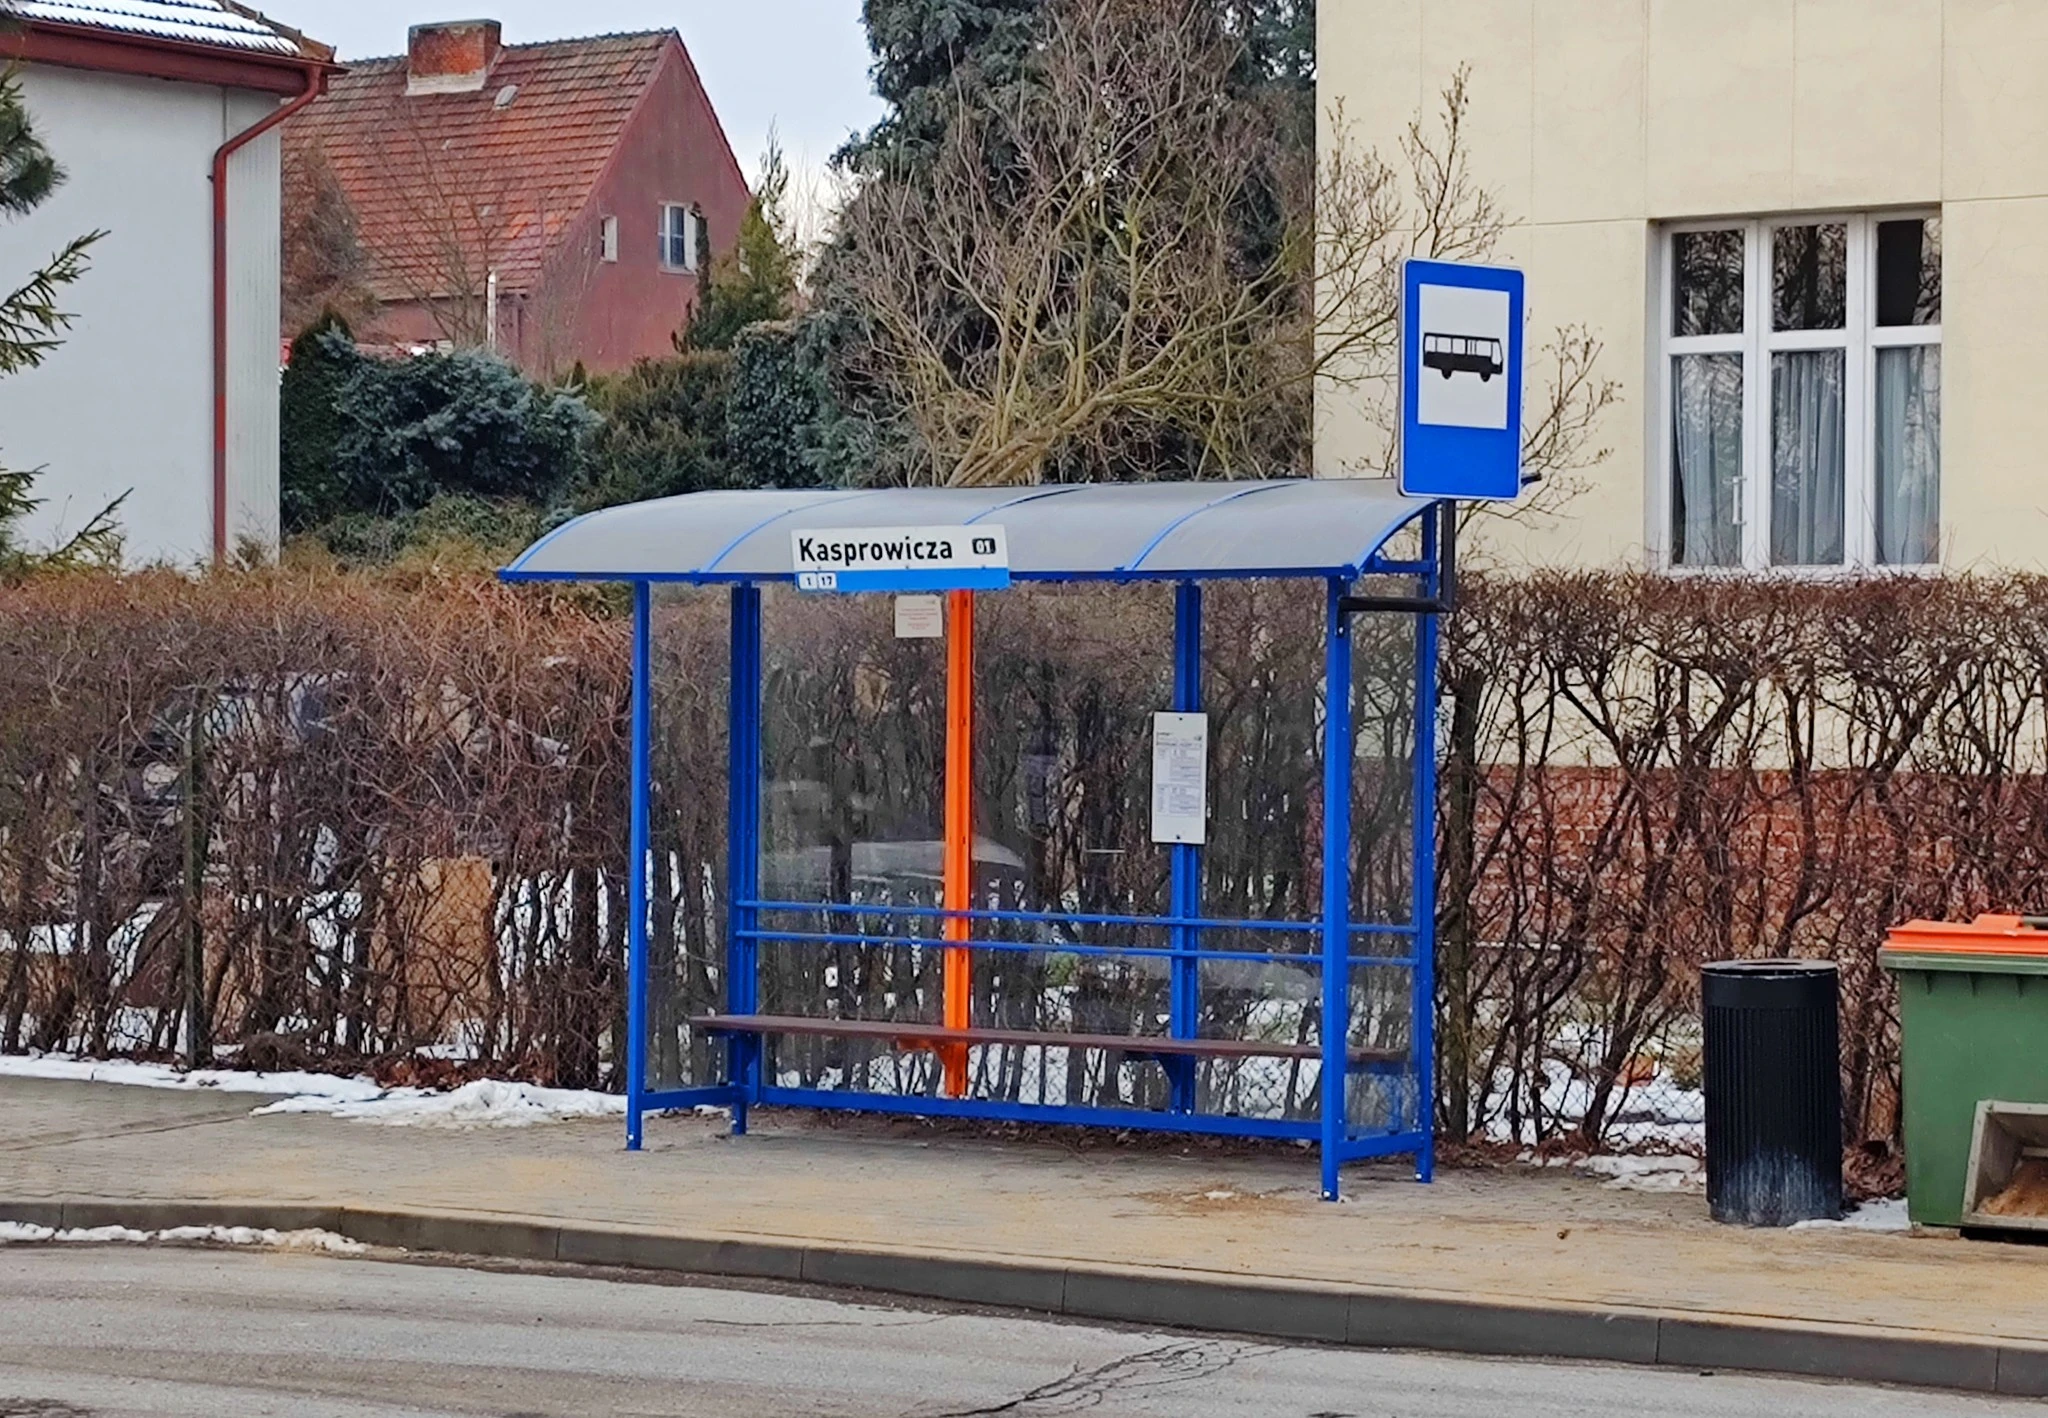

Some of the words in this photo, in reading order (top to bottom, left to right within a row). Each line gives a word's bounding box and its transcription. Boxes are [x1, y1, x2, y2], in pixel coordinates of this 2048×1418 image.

[798, 535, 953, 567] Kasprowicza
[974, 539, 992, 554] 01
[821, 575, 833, 586] 17
